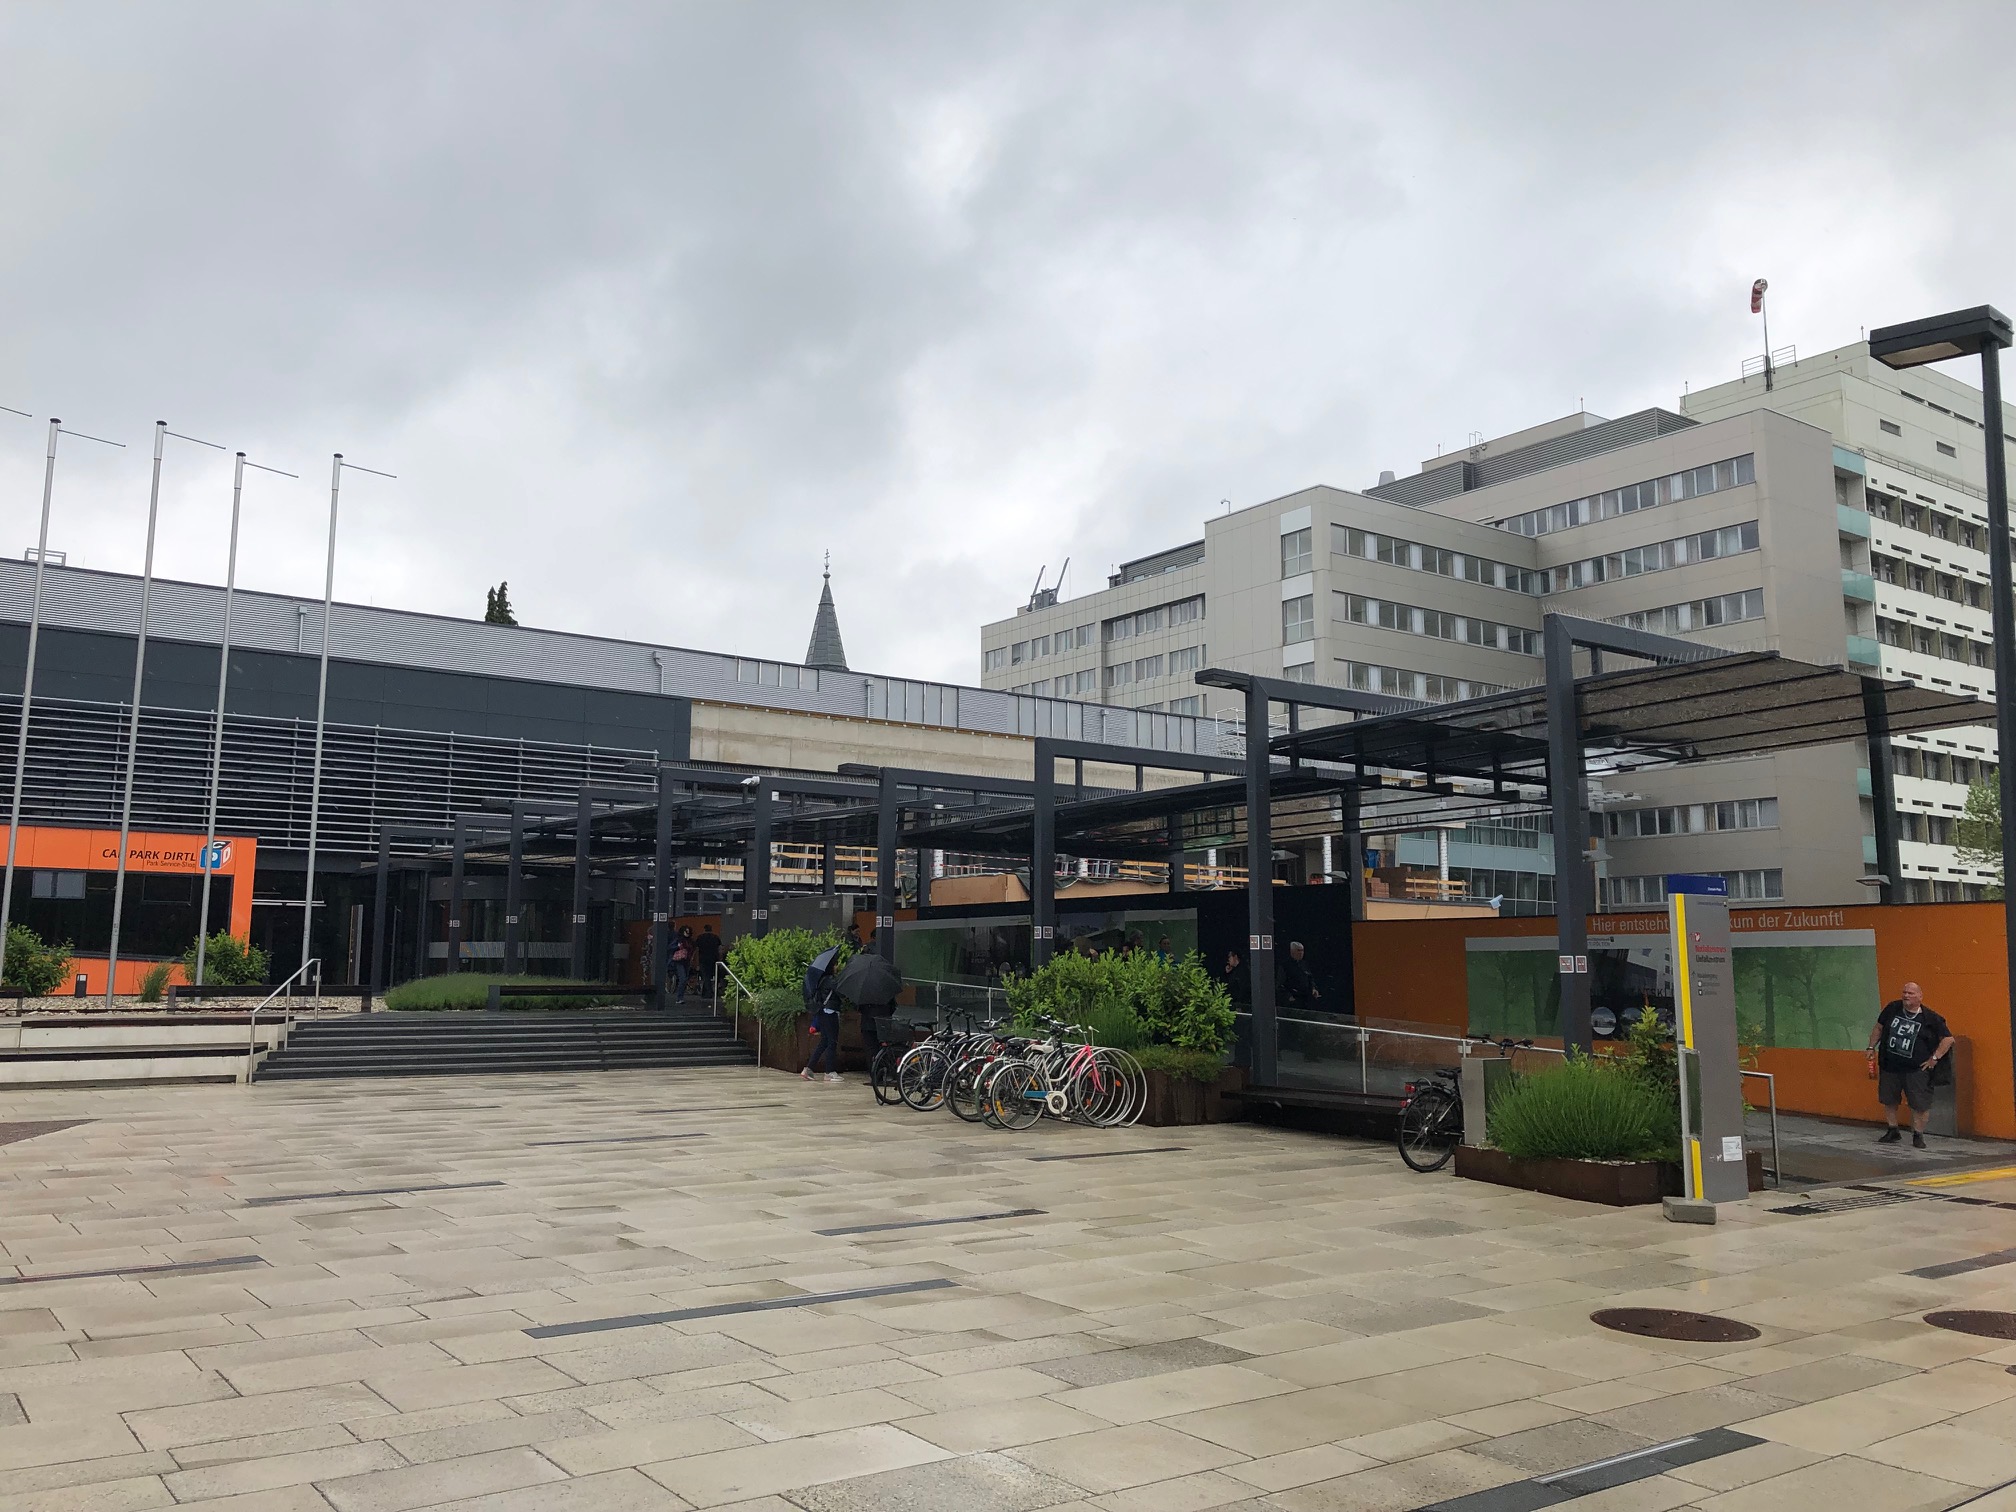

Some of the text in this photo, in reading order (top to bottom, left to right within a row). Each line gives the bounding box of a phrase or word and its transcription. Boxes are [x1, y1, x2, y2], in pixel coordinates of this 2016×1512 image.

[102, 849, 197, 862] CA PARK DIRTL
[1722, 880, 1726, 892] 1
[1592, 917, 1616, 932] Hier
[1619, 916, 1669, 931] entsteht
[1758, 913, 1780, 928] der
[1784, 910, 1844, 928] Zukunft!
